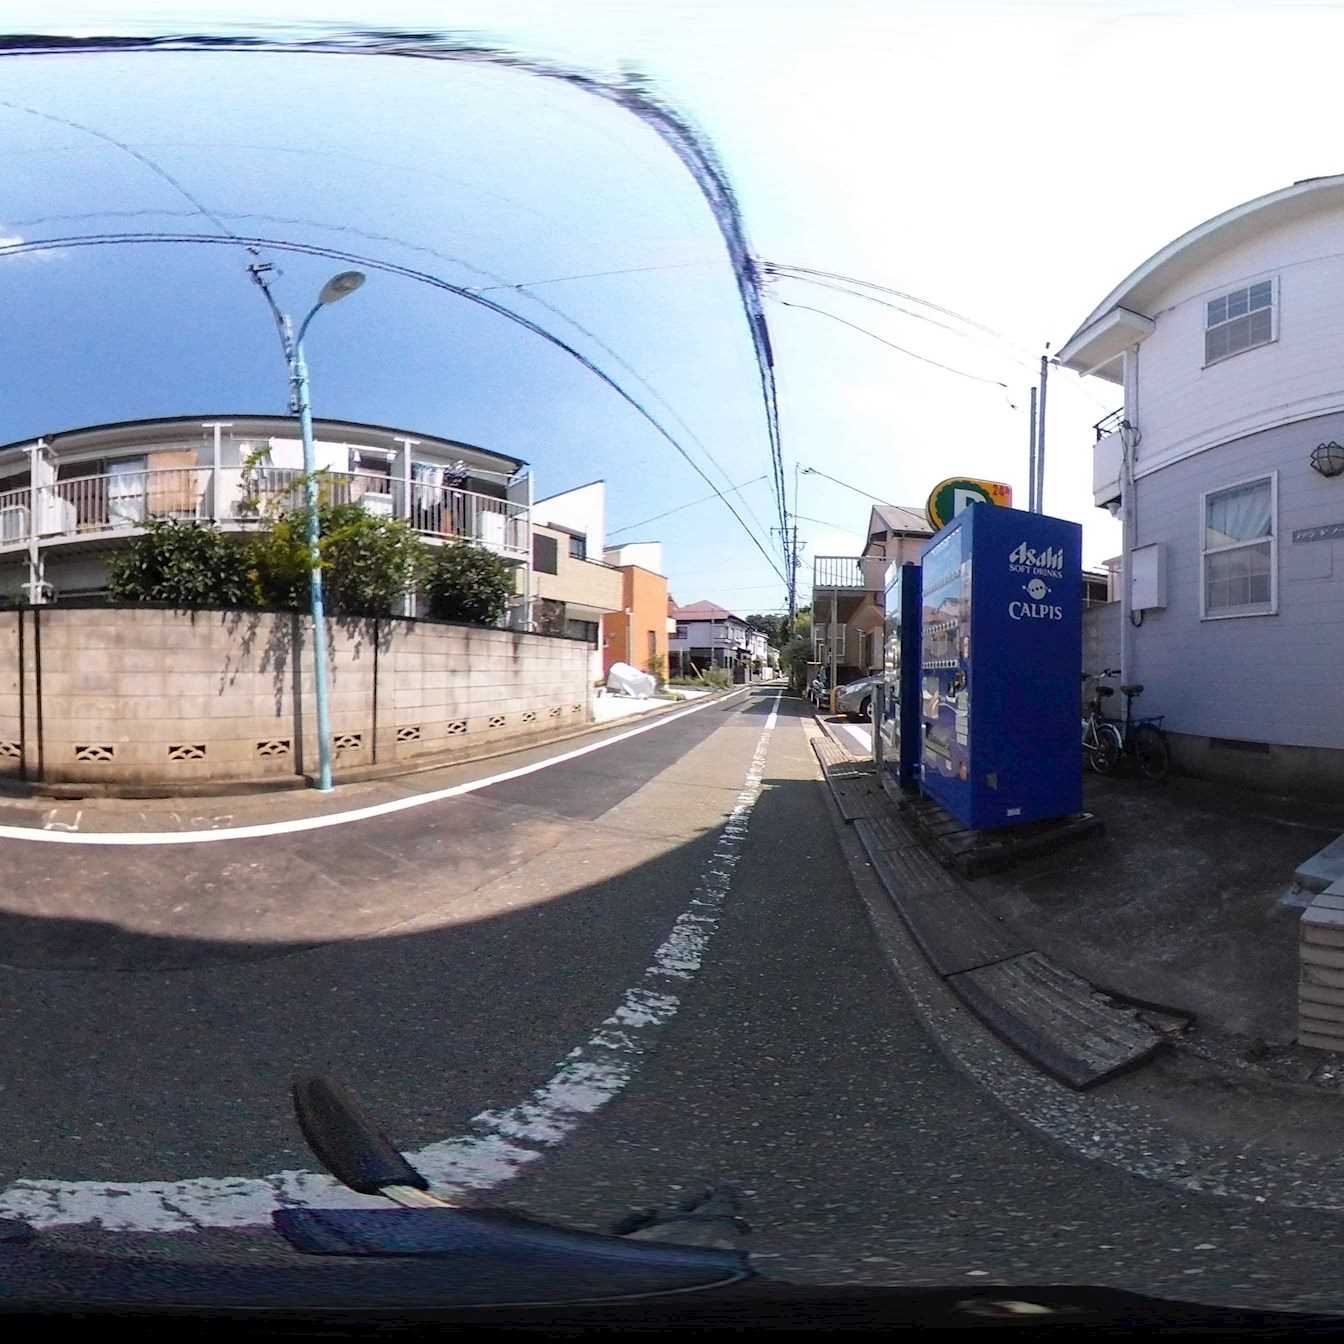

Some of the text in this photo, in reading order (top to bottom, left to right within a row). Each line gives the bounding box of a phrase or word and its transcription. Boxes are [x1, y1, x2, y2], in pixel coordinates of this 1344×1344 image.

[1009, 541, 1063, 570] Asahi
[1008, 563, 1063, 578] SOFT DRINKS
[1008, 601, 1063, 620] CALPIS
